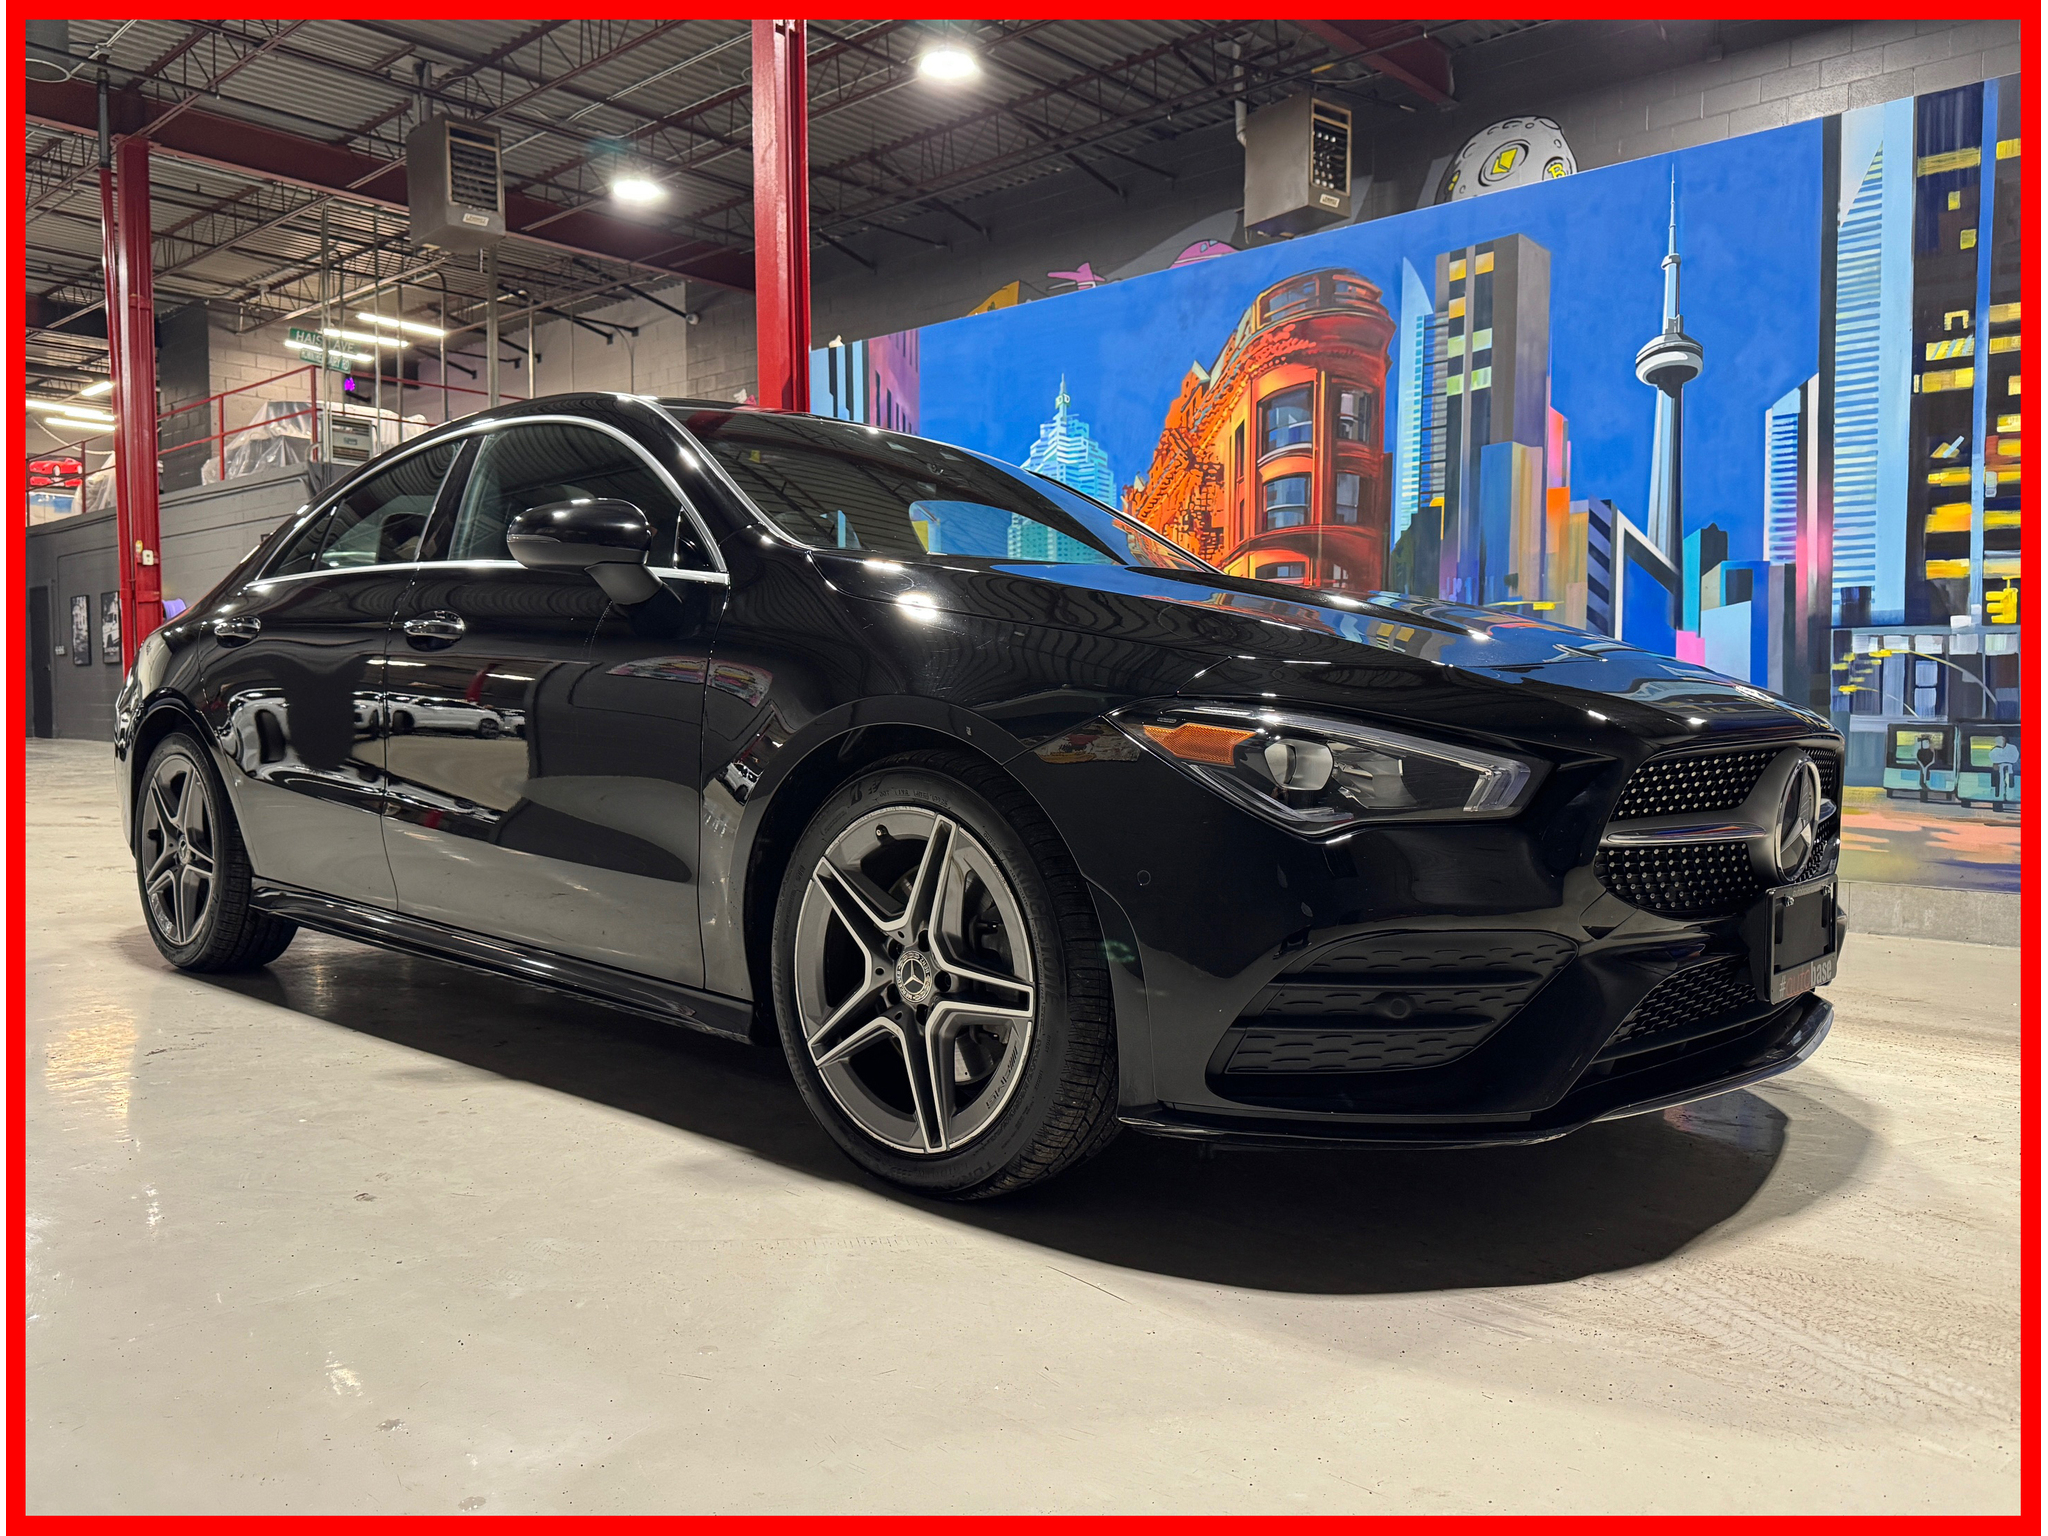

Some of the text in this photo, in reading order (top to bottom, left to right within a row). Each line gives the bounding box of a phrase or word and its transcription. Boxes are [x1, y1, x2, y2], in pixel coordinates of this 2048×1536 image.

[296, 330, 354, 353] HAIS AVE
[1779, 959, 1832, 998] #autobase
